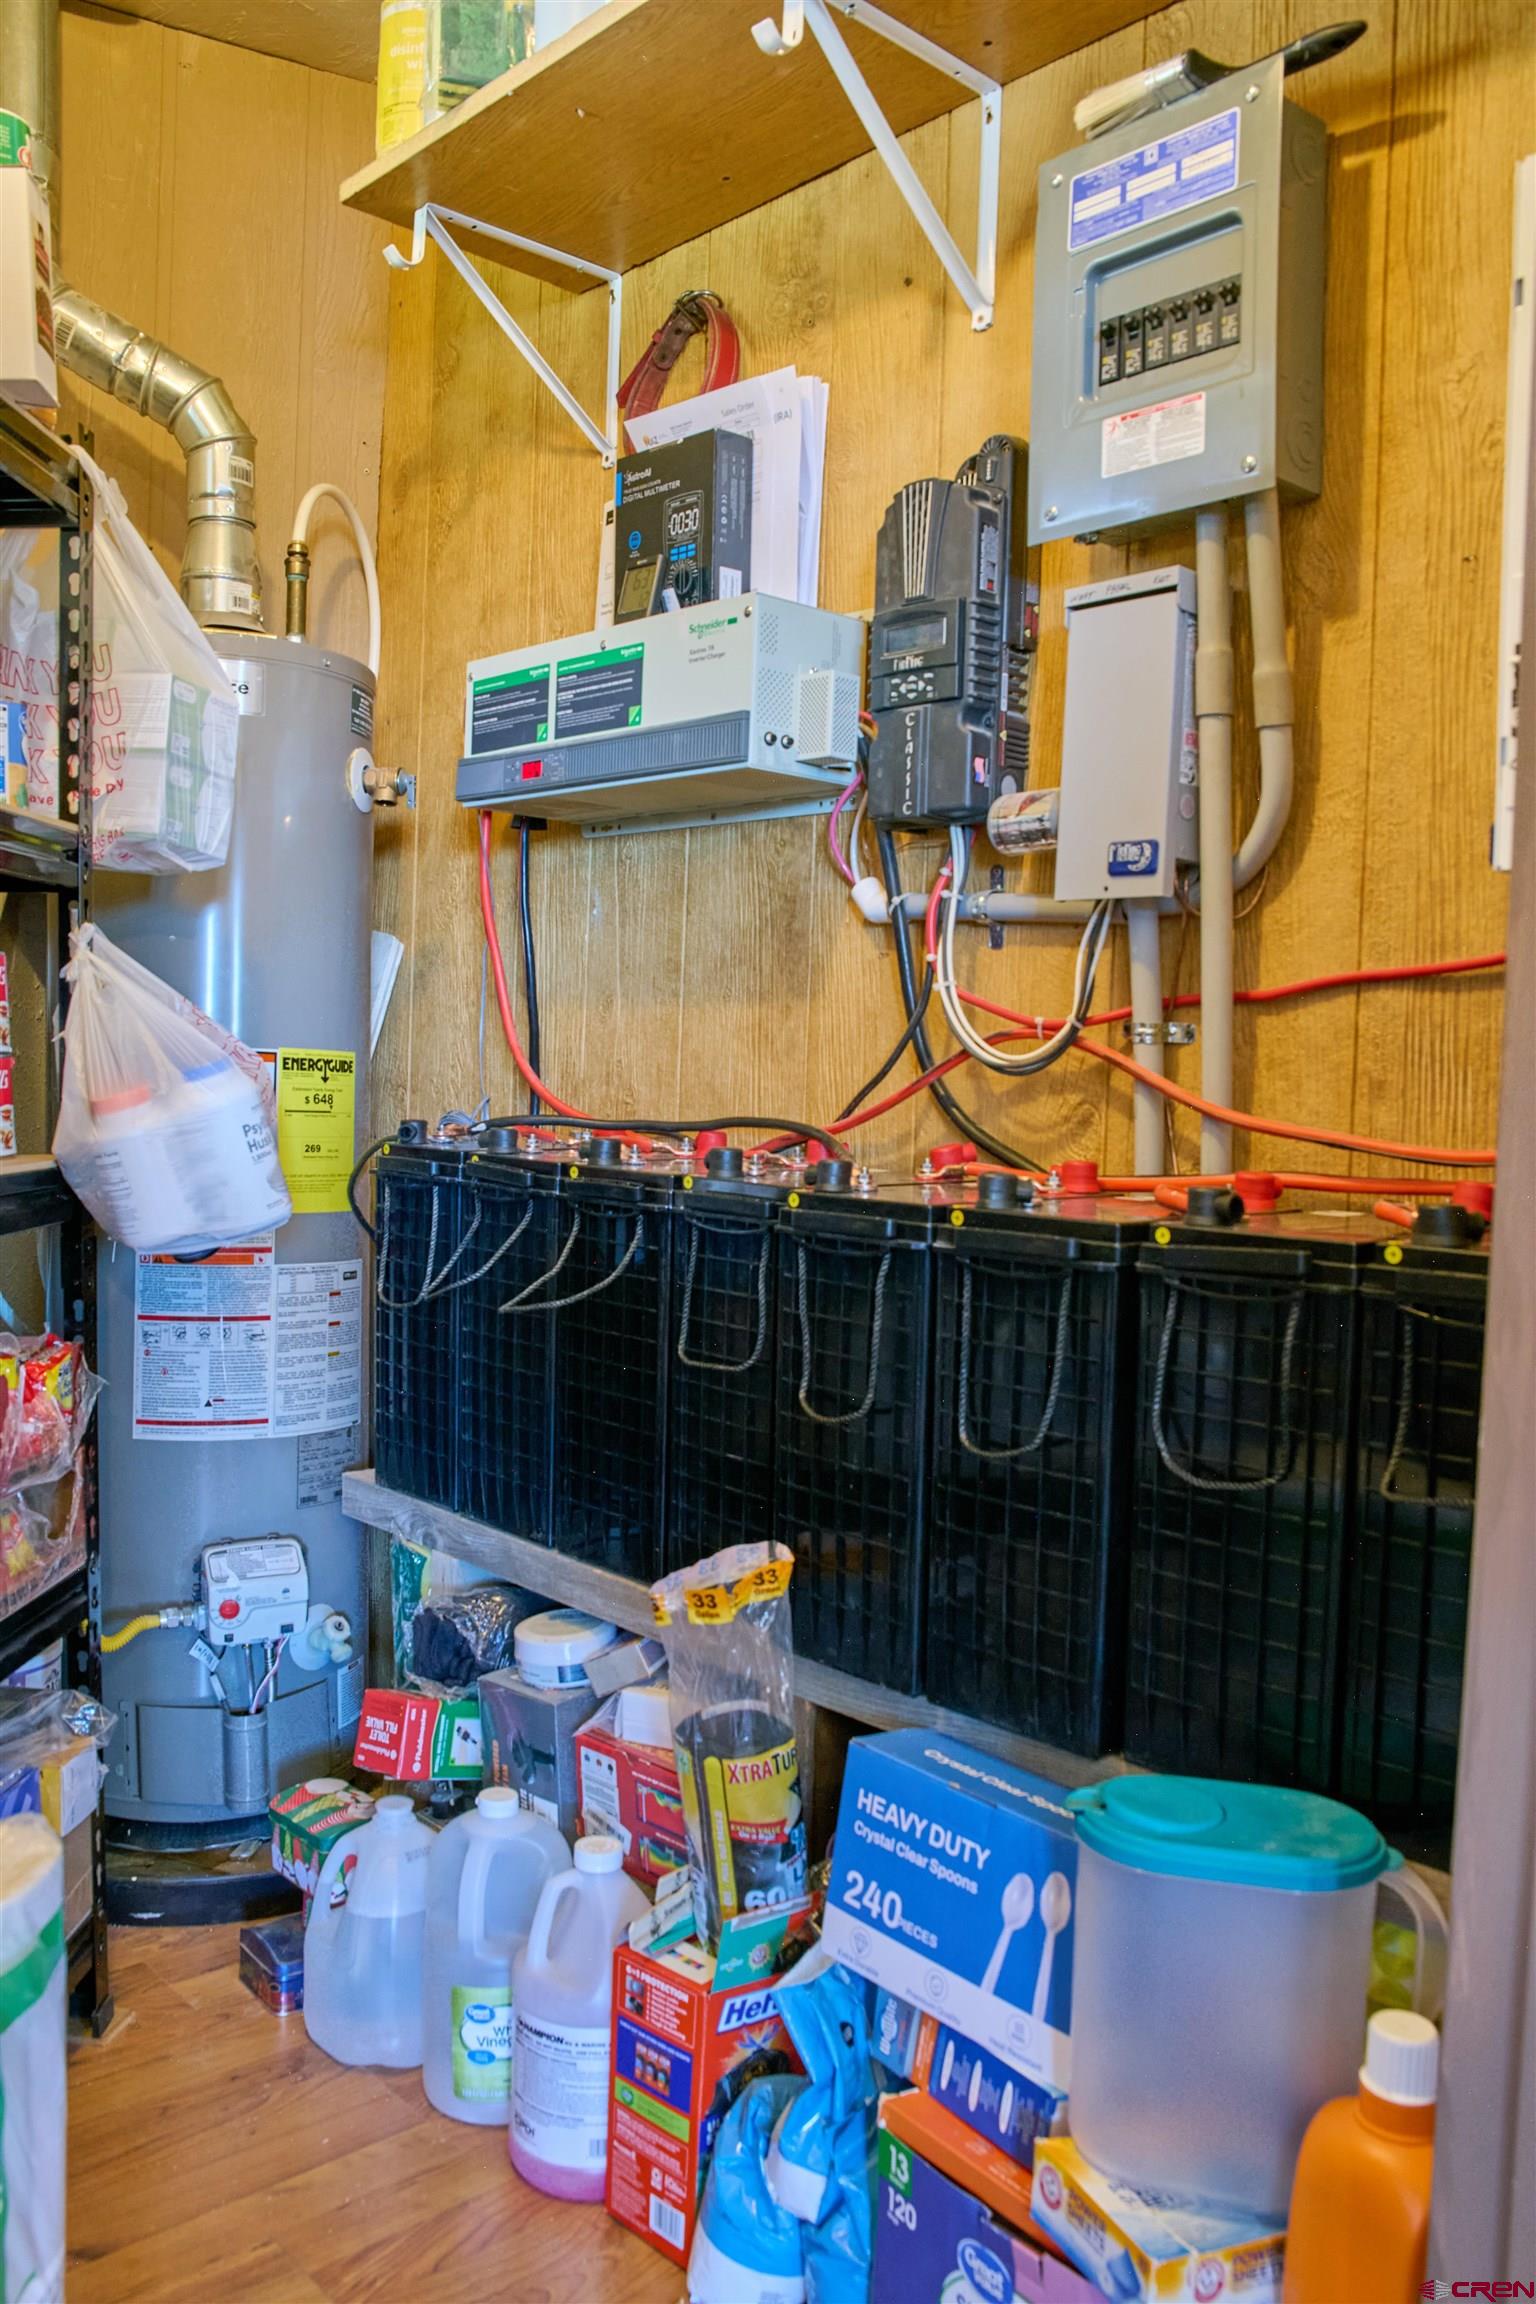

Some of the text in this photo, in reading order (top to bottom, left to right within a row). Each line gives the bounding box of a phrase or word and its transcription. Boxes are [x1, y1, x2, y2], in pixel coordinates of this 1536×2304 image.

[688, 617, 727, 635] Schneider
[901, 711, 916, 816] CLASSIC
[313, 1093, 334, 1105] 648
[304, 1144, 321, 1153] 269
[752, 1568, 779, 1587] 33
[691, 1593, 718, 1609] 33
[857, 1787, 991, 1871] HEAVY DUTY
[854, 1820, 979, 1895] Crystal Clear Spoons
[842, 1869, 903, 1930] 240
[889, 2143, 911, 2184] 13
[887, 2185, 918, 2233] 120
